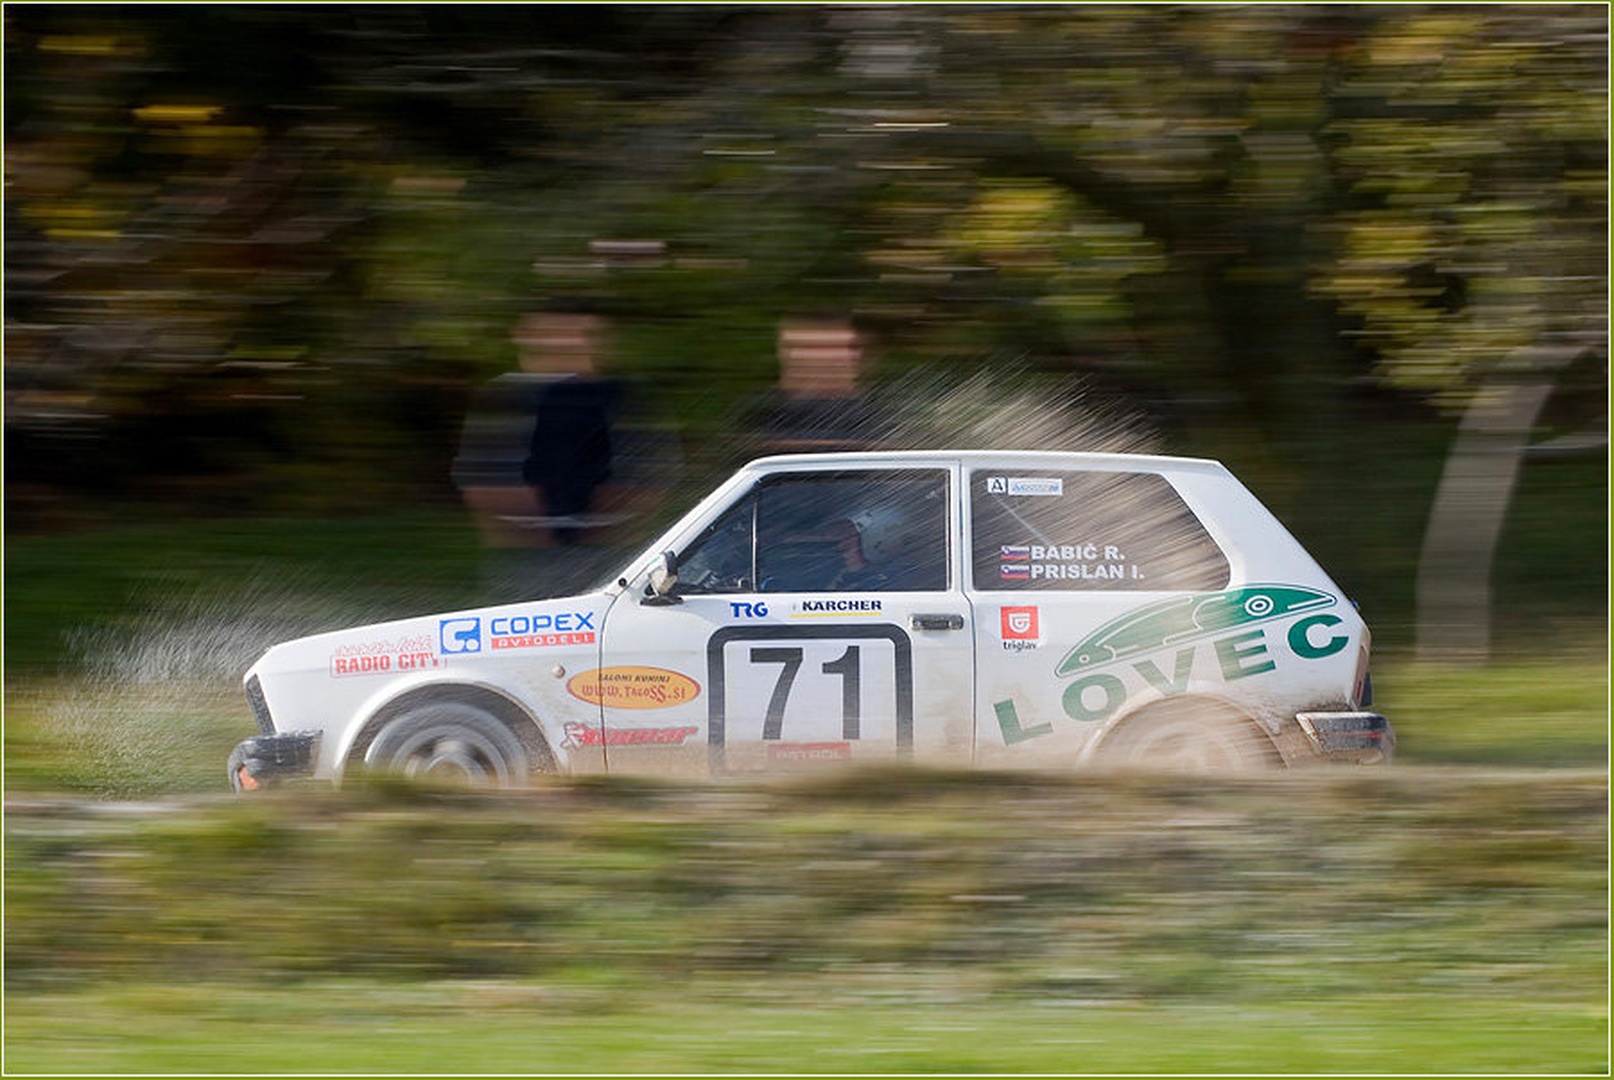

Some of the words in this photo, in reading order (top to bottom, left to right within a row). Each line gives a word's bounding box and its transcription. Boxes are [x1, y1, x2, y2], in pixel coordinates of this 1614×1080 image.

[1104, 546, 1126, 560] R.
[1031, 564, 1124, 579] PRISLAN
[730, 602, 768, 618] TRG
[491, 612, 594, 636] COPEX
[335, 654, 391, 674] RADIO
[993, 614, 1349, 746] LOVEC
[750, 645, 860, 740] 71
